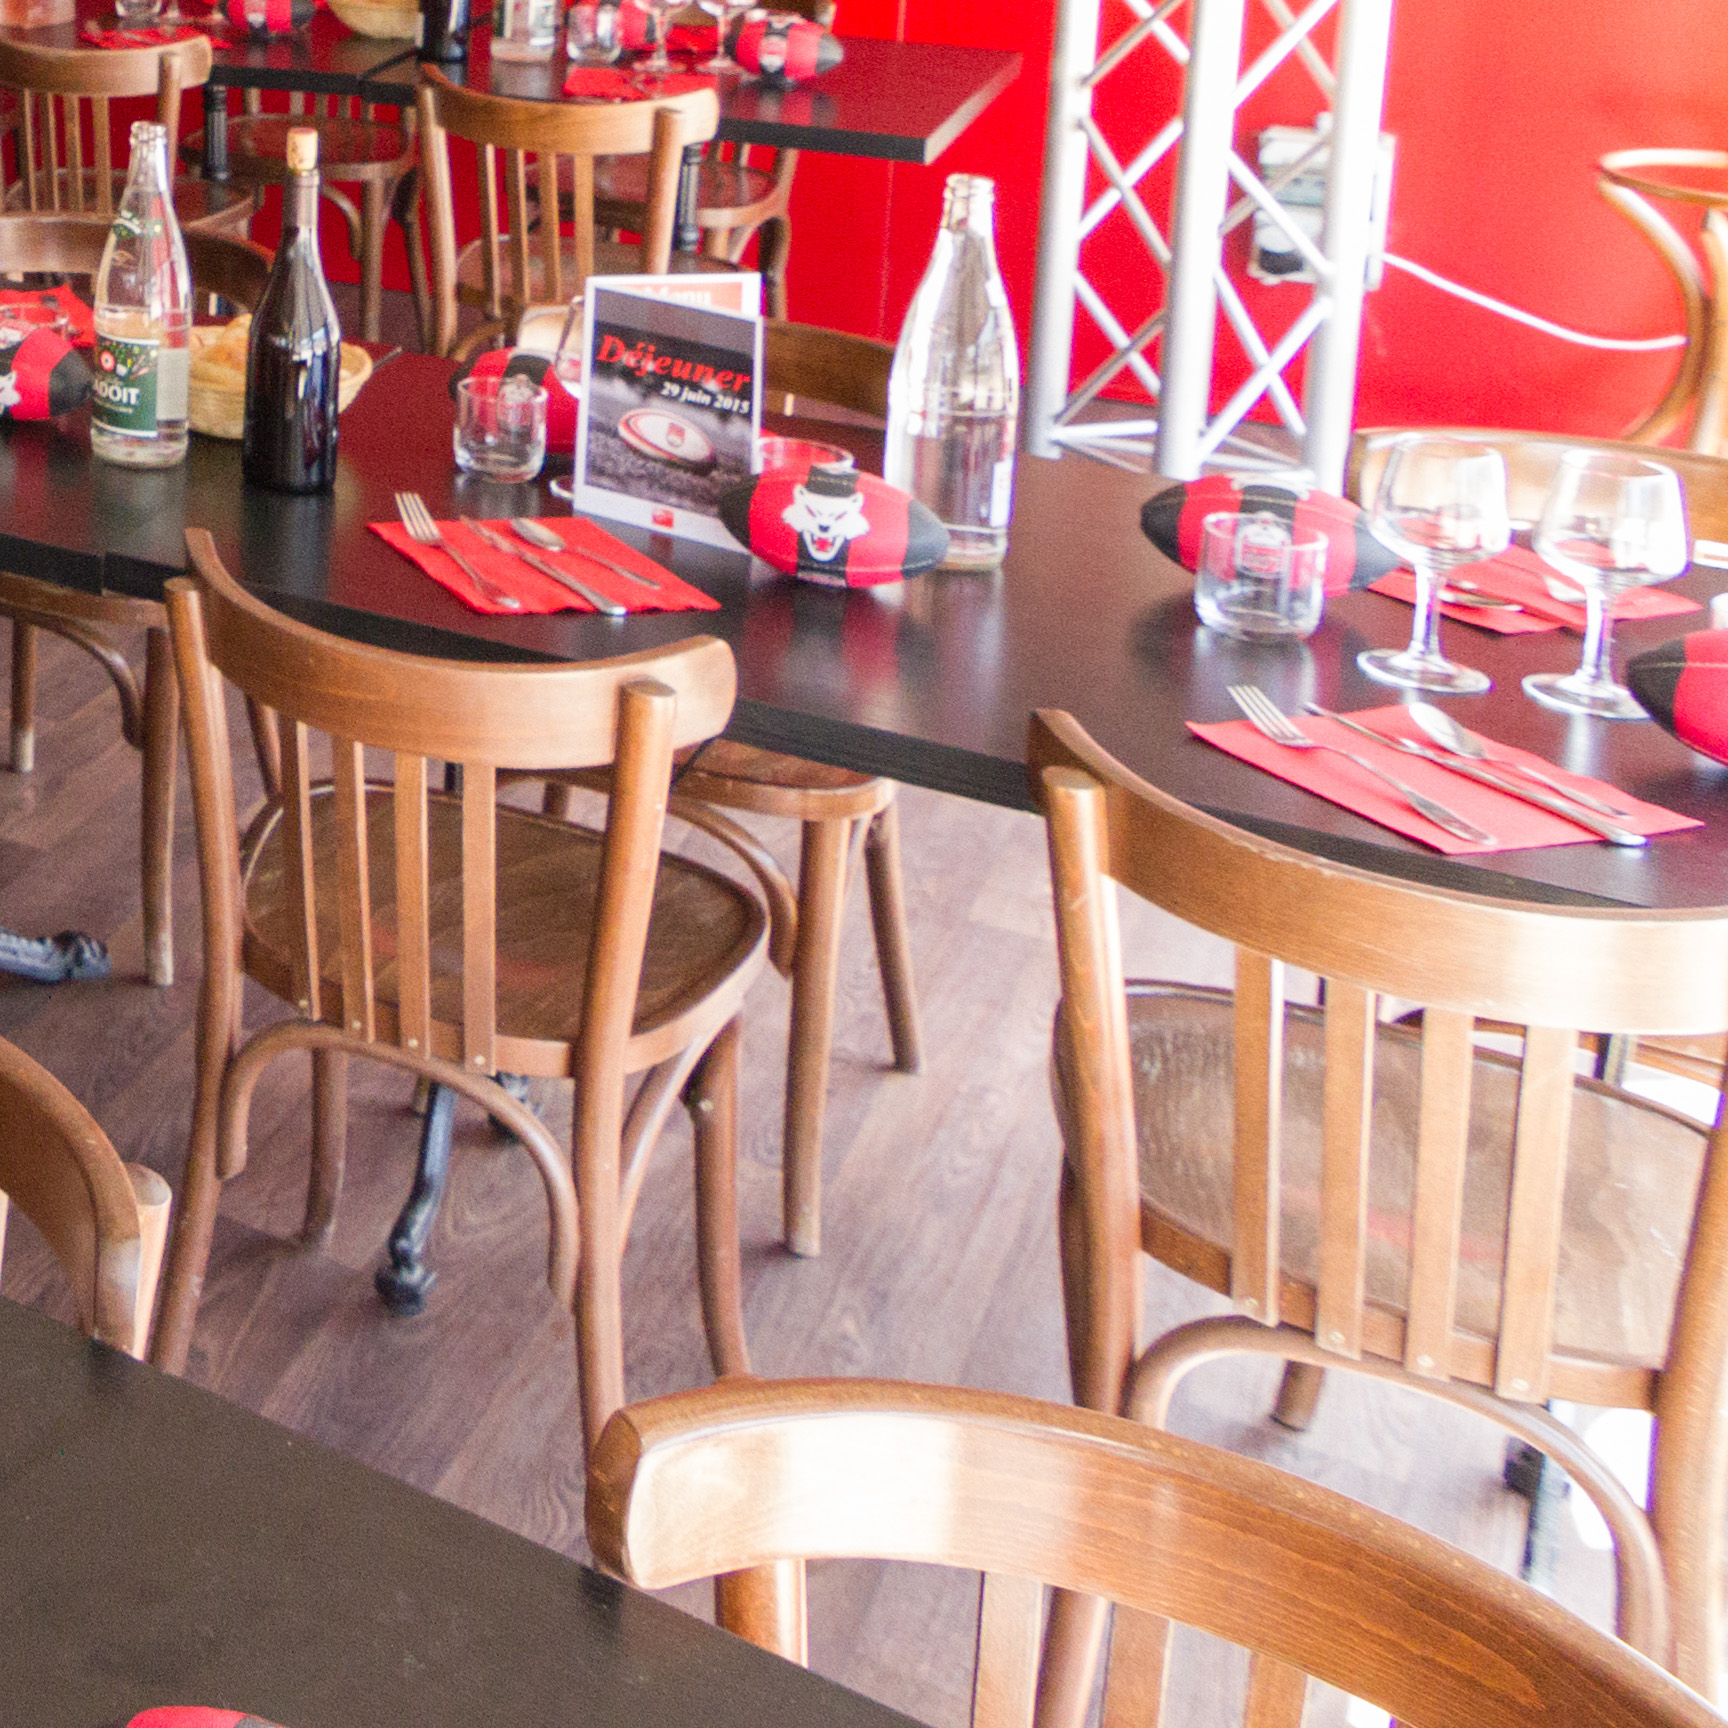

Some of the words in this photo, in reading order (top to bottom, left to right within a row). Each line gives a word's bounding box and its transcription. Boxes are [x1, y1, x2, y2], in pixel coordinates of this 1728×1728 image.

[596, 334, 751, 392] Déjeuner
[661, 381, 681, 397] 29
[681, 385, 712, 406] juin
